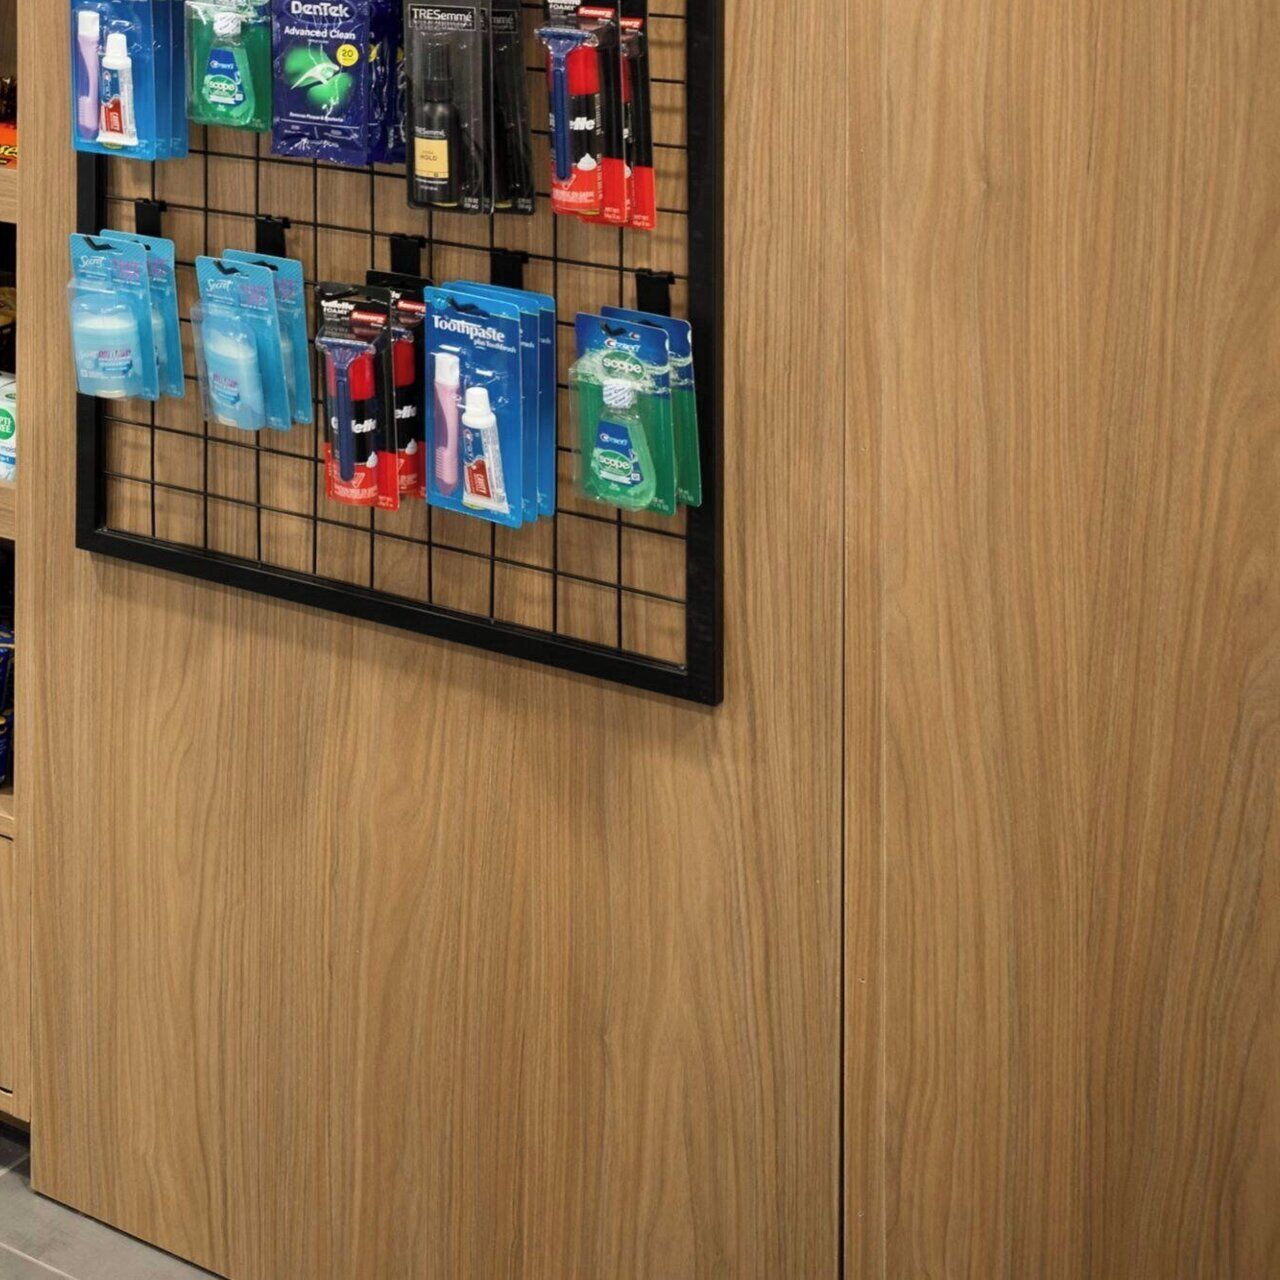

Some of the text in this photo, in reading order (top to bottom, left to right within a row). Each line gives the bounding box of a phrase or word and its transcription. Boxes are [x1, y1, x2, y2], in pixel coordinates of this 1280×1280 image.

[291, 0, 350, 18] DenTek
[412, 8, 472, 23] TRESemmé
[284, 25, 357, 41] Advanced Clean
[341, 49, 354, 58] 20
[208, 80, 236, 92] scope
[431, 314, 505, 342] Toothpaste
[603, 356, 642, 373] scope
[598, 454, 630, 470] scope
